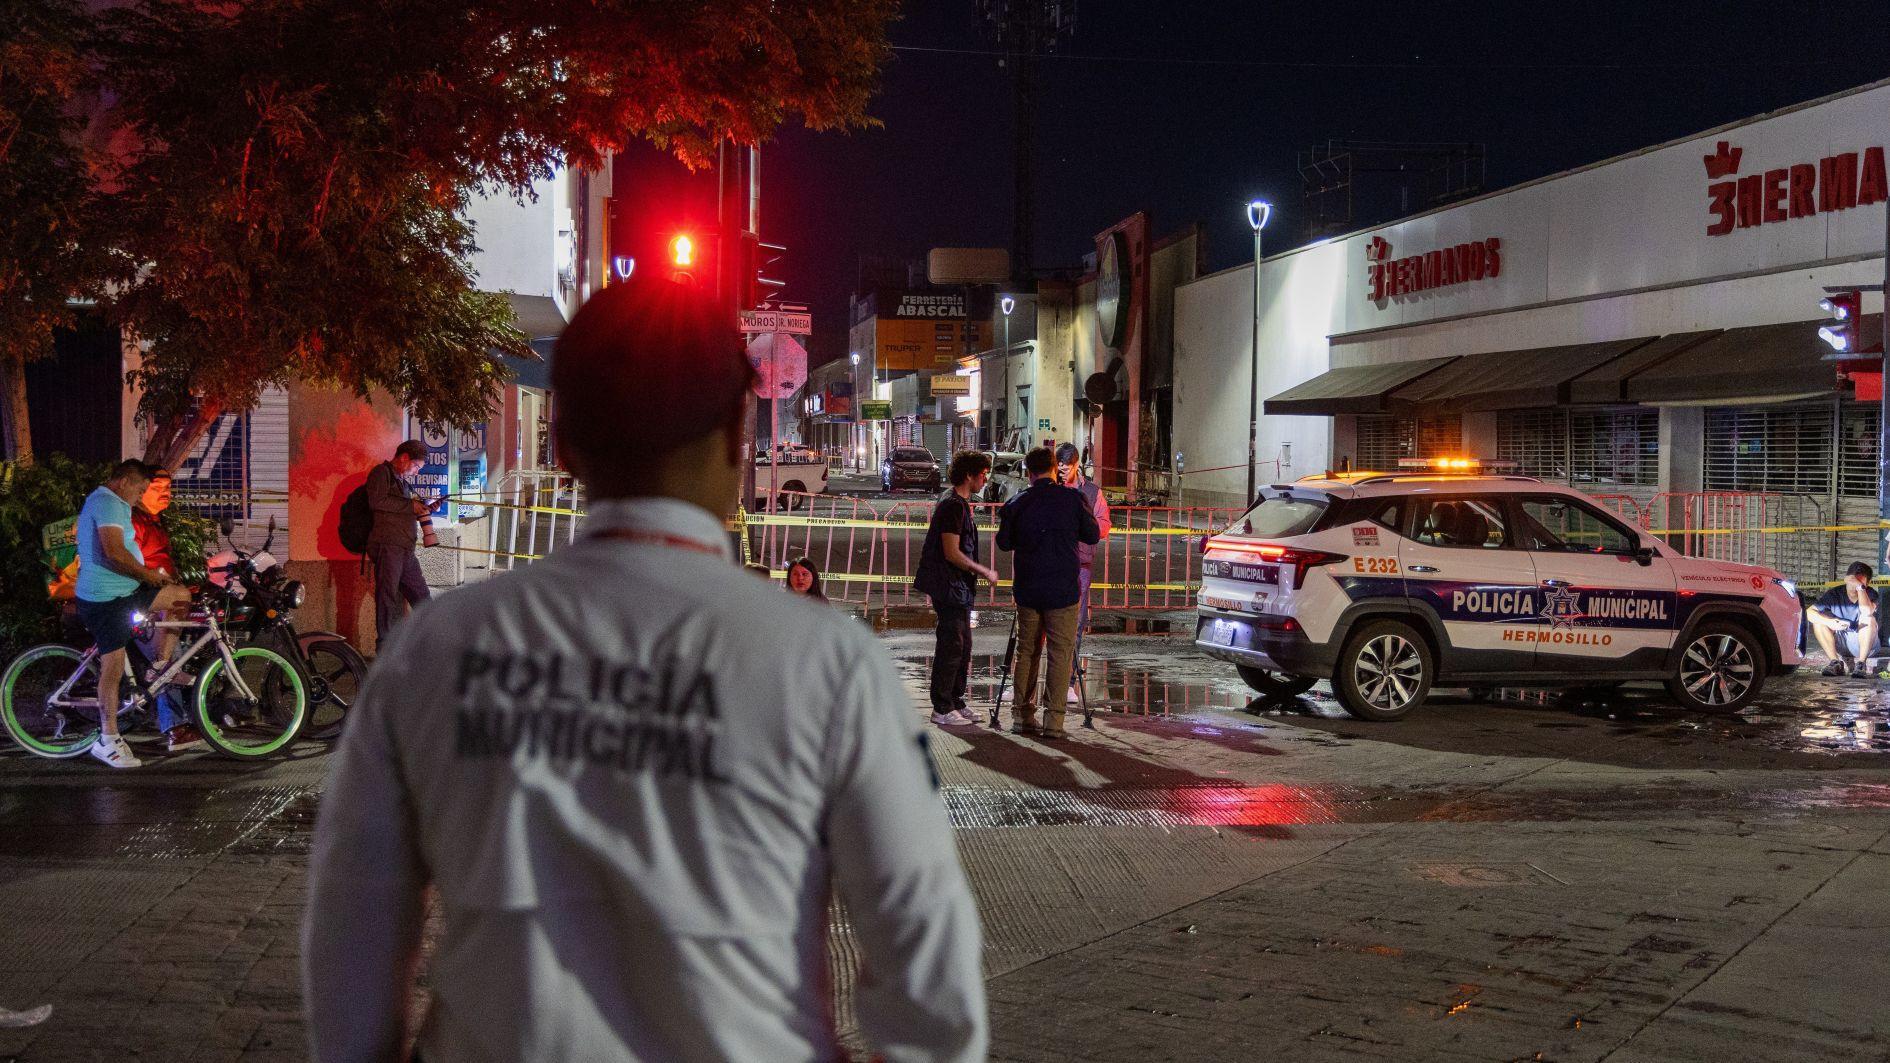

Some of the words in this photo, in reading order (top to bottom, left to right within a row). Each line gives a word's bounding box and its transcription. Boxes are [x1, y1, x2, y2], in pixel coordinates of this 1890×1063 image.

[896, 304, 967, 317] ABASCAL
[417, 474, 448, 486] REVISAR
[1232, 566, 1266, 581] MUNICIPAL
[1354, 557, 1366, 573] E
[1367, 557, 1399, 574] 232
[1205, 595, 1243, 610] HERMOSILLO
[1452, 590, 1534, 615] POLICÍA
[1587, 597, 1668, 620] MUNICIPAL
[1502, 629, 1612, 647] HERMOSILLO
[458, 650, 721, 718] POLICÍA
